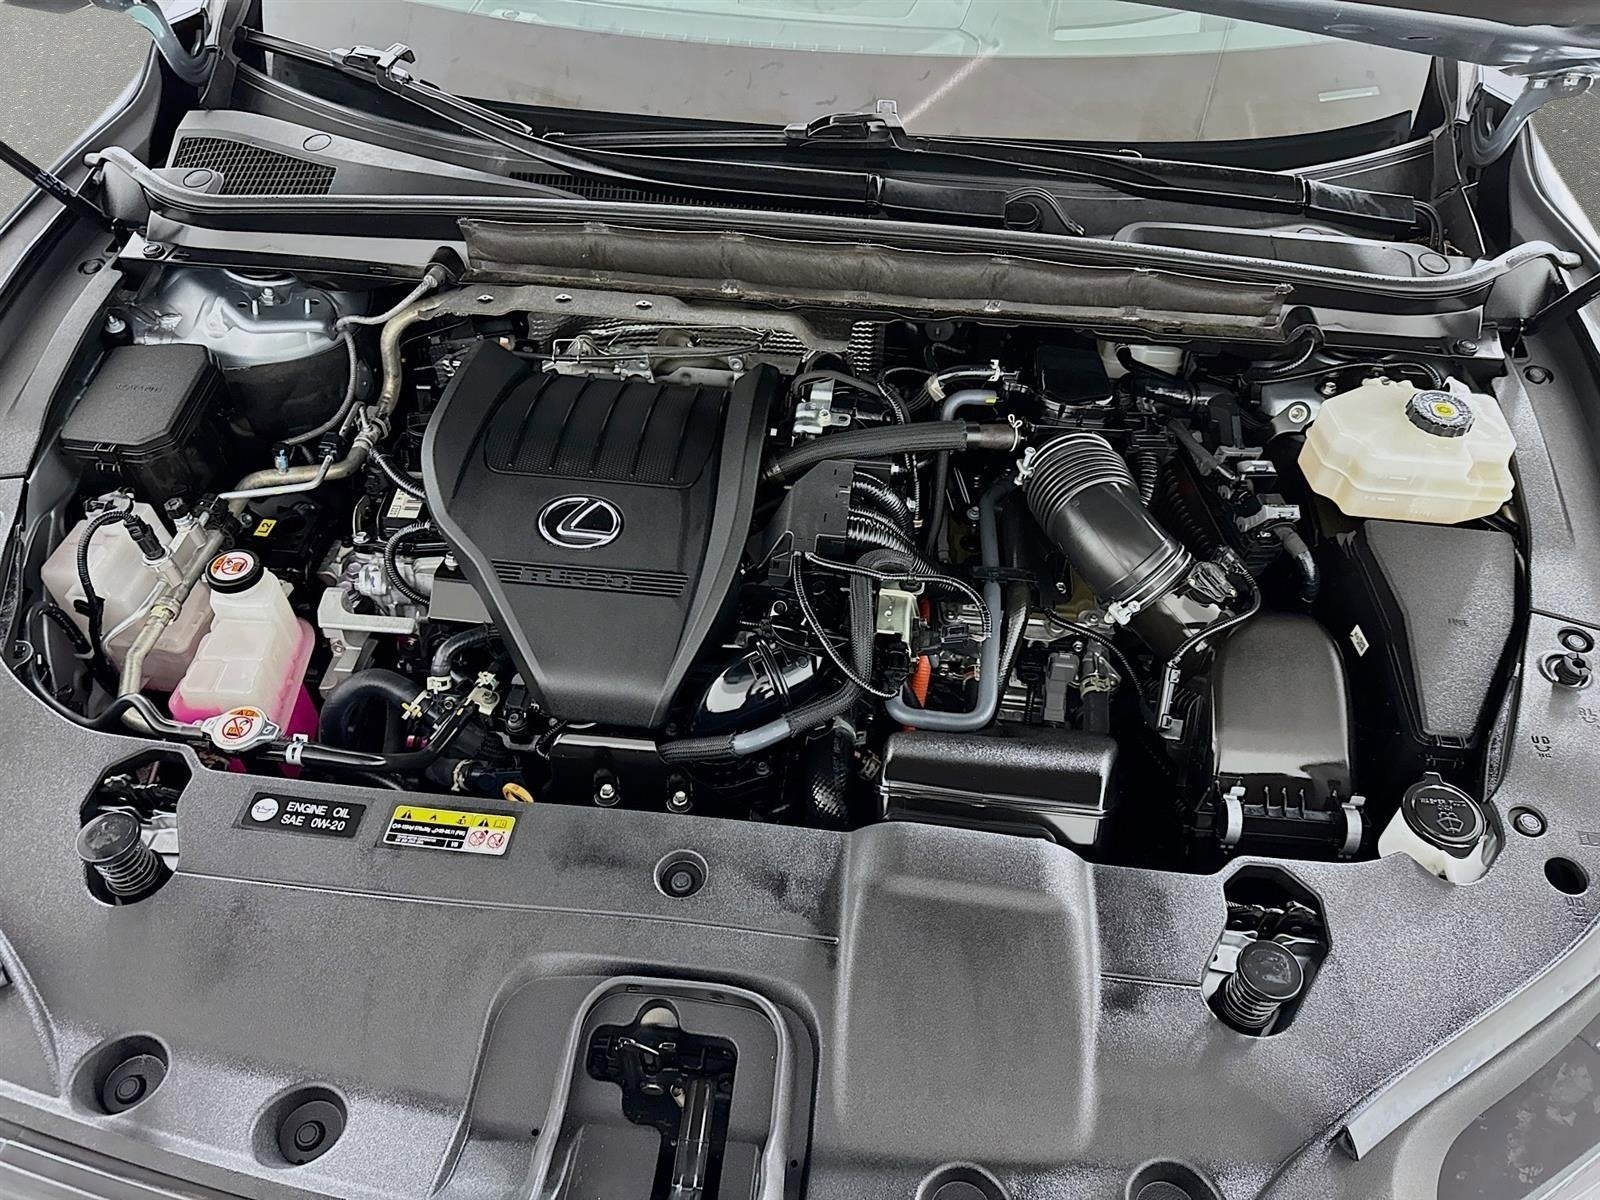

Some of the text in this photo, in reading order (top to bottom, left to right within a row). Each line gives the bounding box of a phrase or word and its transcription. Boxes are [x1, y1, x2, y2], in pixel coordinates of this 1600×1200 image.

[520, 565, 632, 591] TURBO
[286, 801, 351, 819] ENGINE OIL
[280, 813, 346, 831] SAE 0W-20
